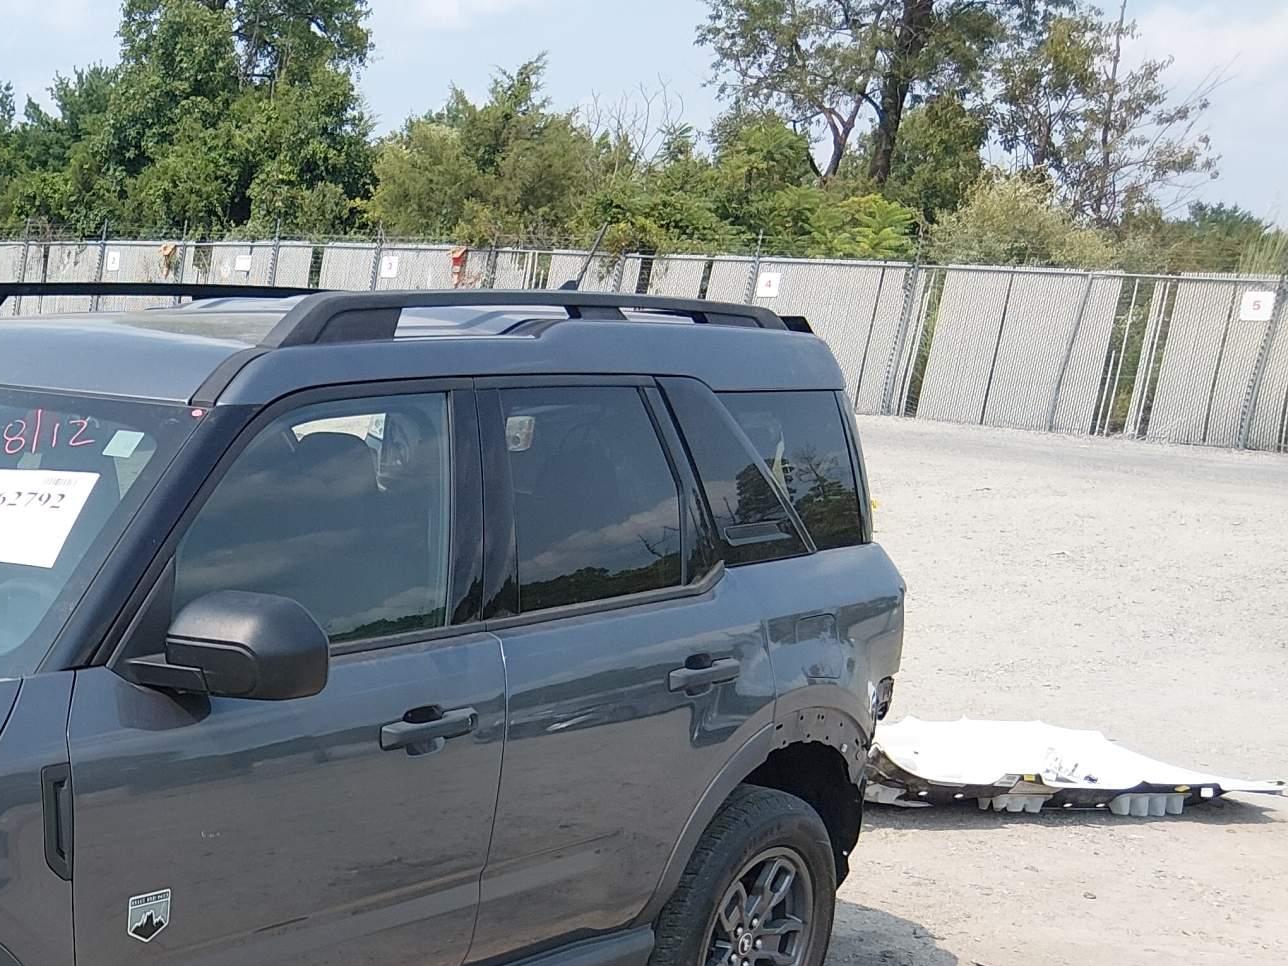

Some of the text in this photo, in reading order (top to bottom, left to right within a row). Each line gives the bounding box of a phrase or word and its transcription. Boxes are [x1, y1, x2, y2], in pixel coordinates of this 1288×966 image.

[764, 280, 772, 288] 4
[1252, 300, 1262, 311] 5
[3, 409, 95, 455] 8/12
